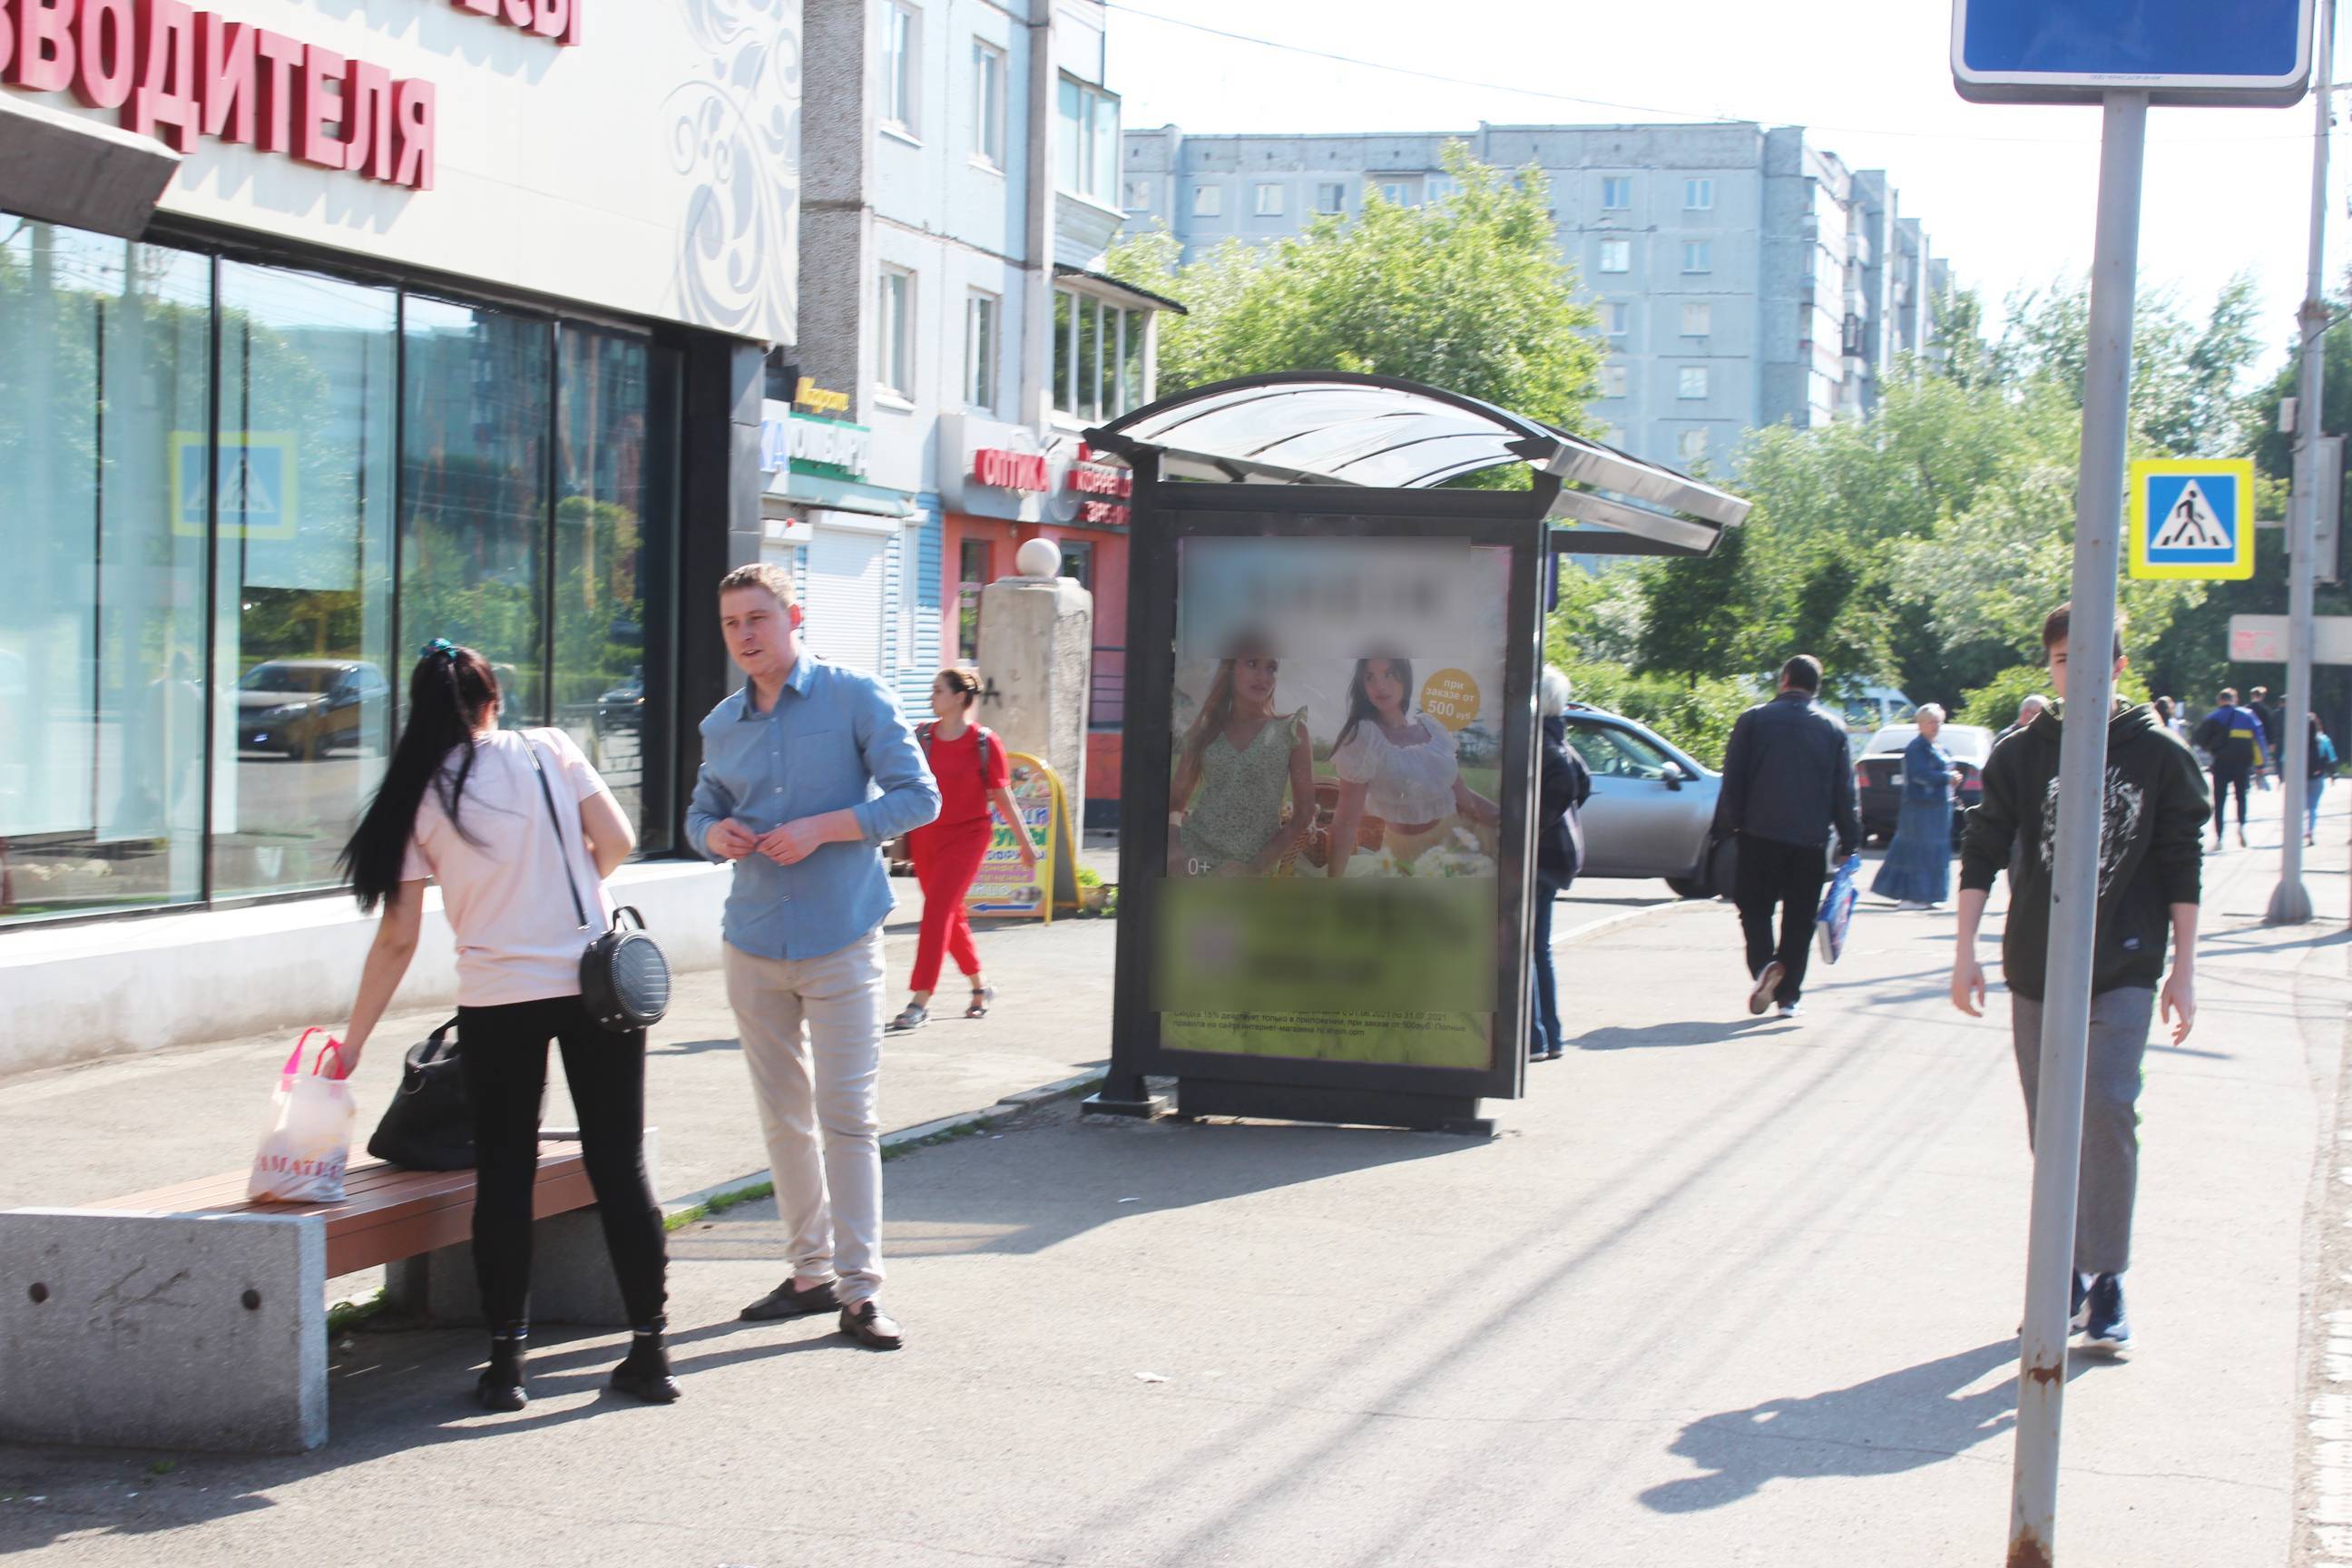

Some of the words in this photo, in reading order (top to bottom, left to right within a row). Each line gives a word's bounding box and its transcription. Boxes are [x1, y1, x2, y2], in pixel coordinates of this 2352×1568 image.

[975, 448, 1050, 493] ОПТИКА
[1444, 680, 1465, 690] при
[1462, 694, 1475, 702] от
[1427, 700, 1455, 717] 500
[1189, 858, 1212, 875] 0+
